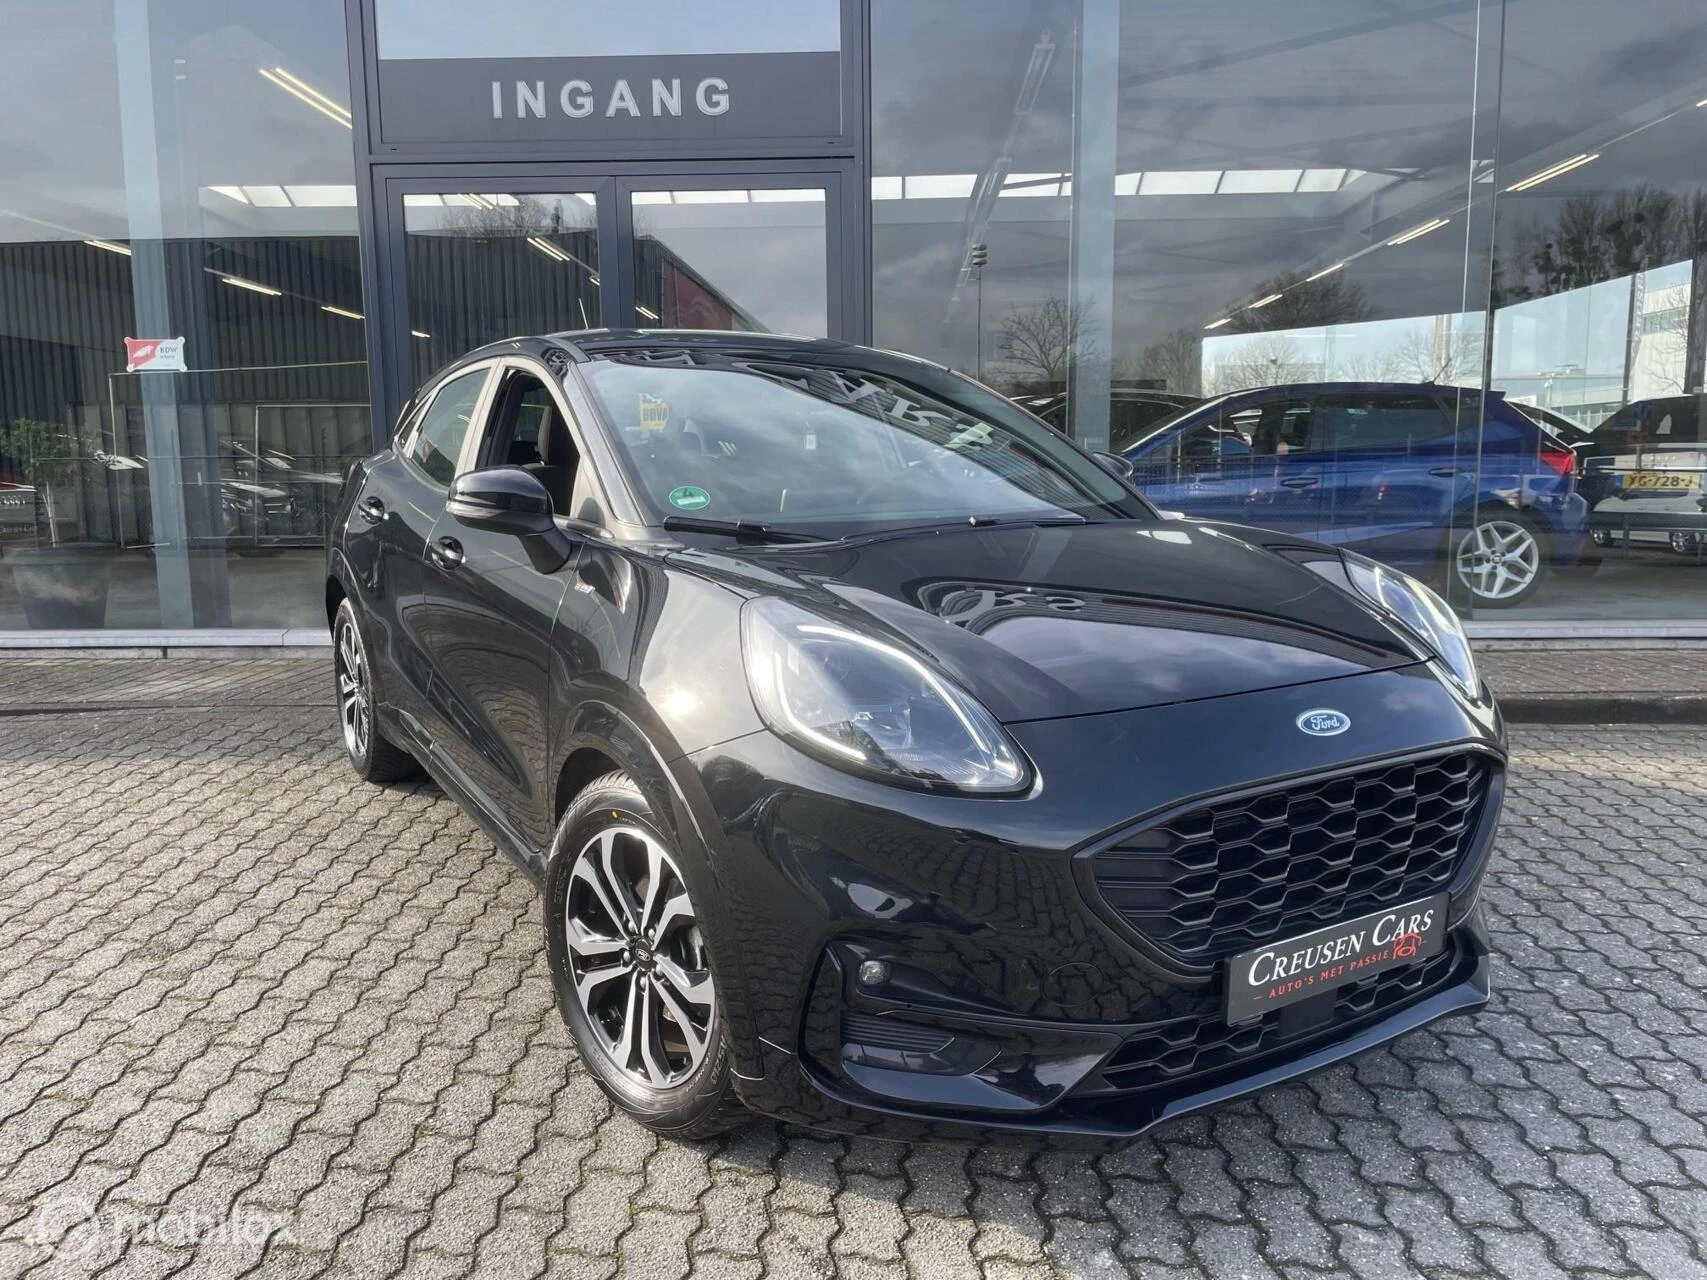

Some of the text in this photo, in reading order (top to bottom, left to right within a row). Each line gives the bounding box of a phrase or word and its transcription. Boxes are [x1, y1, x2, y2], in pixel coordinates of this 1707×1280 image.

[491, 77, 731, 119] INGANG
[1248, 909, 1435, 987] CREUSEN CARS
[1268, 949, 1390, 1000] AUTO'S MET PASSIE
